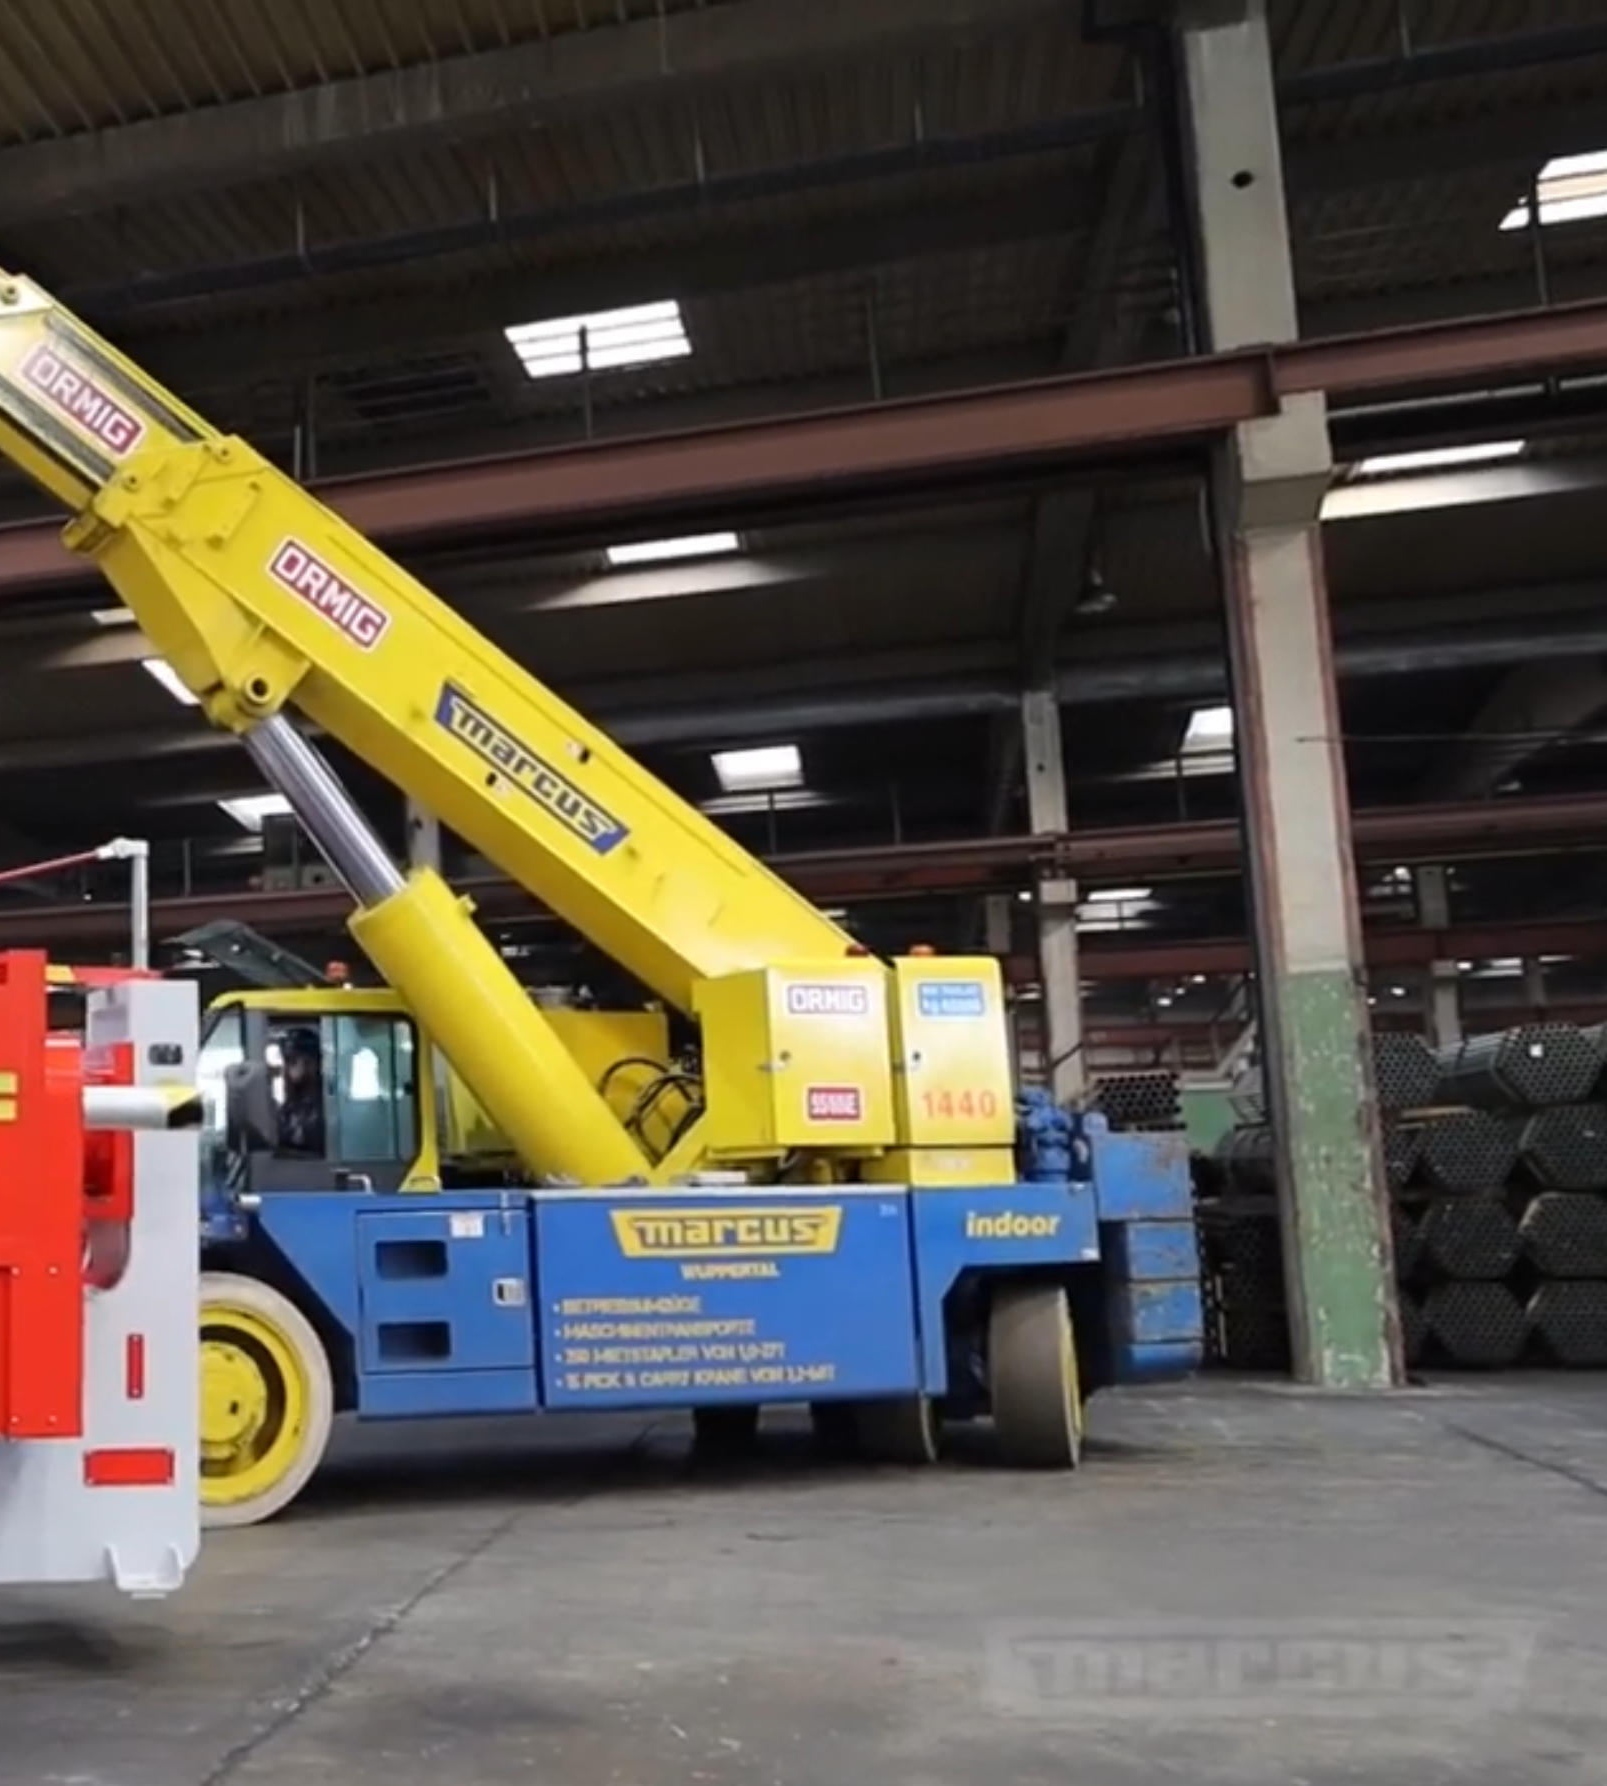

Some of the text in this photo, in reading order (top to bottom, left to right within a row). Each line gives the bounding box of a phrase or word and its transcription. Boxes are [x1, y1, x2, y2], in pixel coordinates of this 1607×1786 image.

[30, 352, 137, 452] ORMIG
[275, 543, 383, 646] ORMIG
[448, 695, 616, 844] marcus
[792, 987, 865, 1012] ORMIG
[923, 1090, 997, 1118] 1440
[633, 1217, 828, 1247] marcus
[966, 1210, 1061, 1238] indoor
